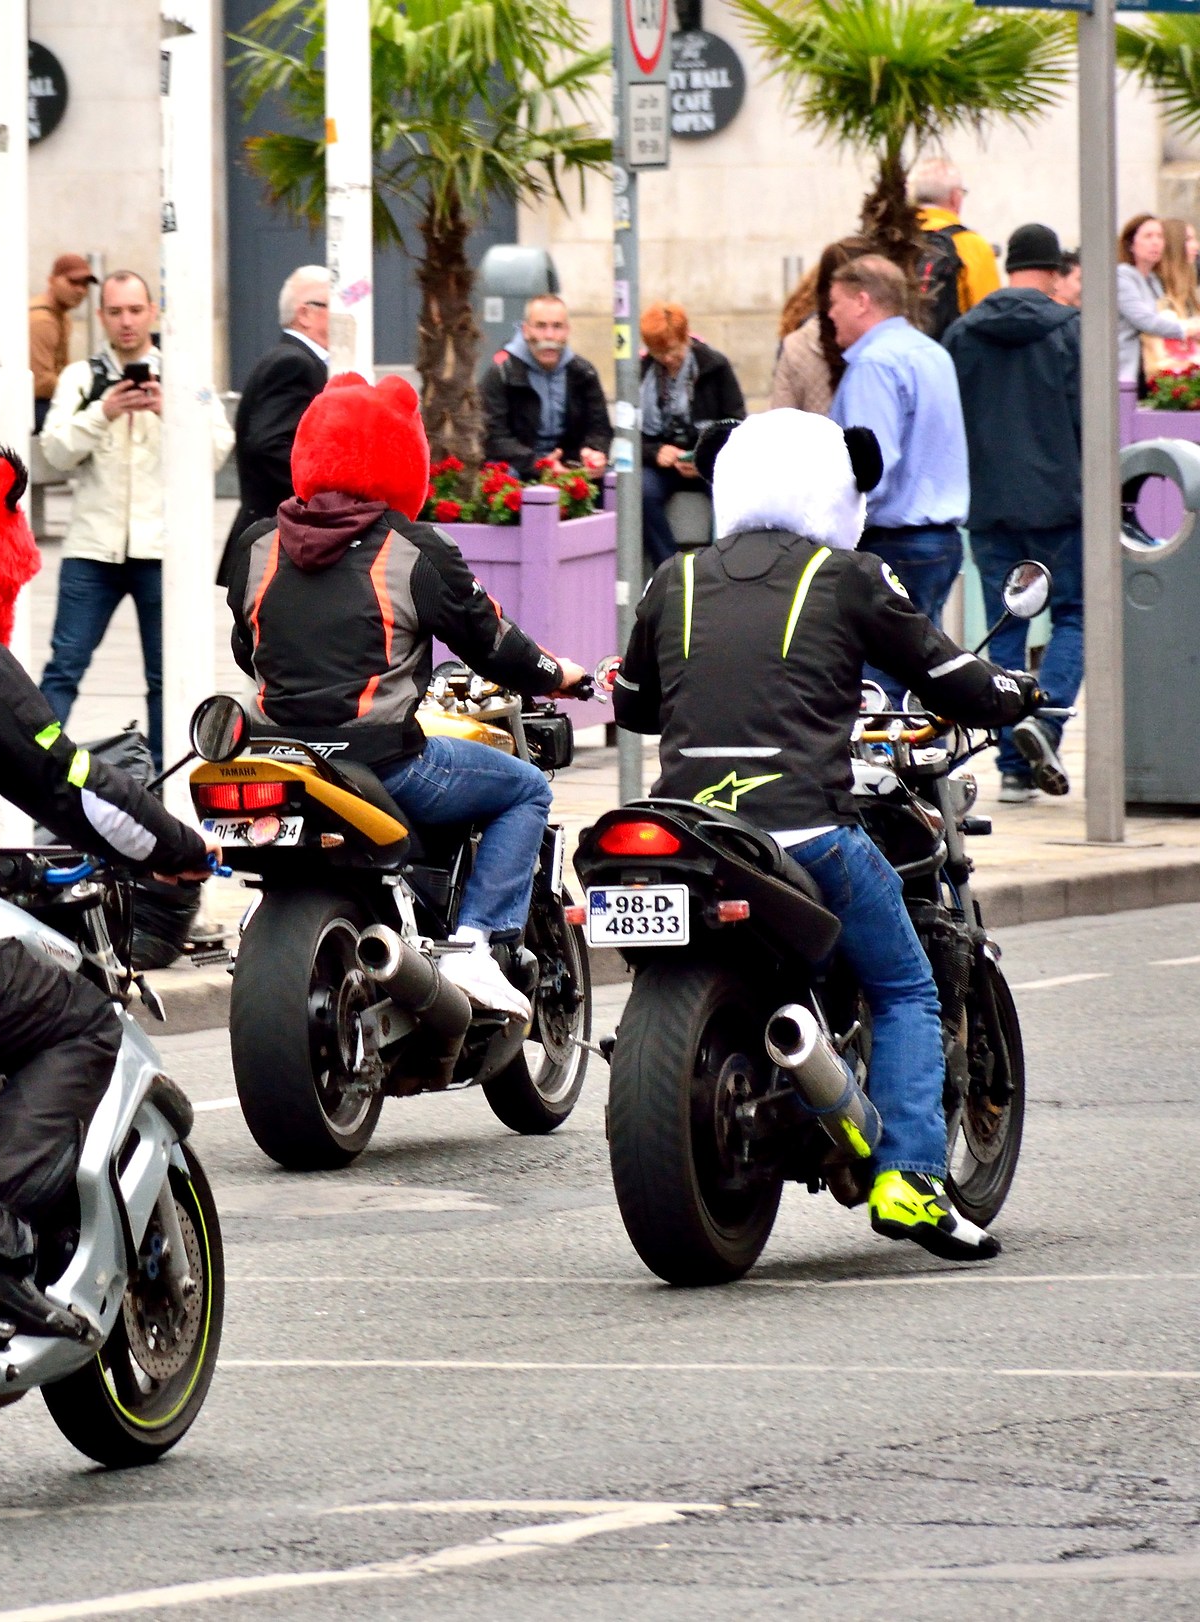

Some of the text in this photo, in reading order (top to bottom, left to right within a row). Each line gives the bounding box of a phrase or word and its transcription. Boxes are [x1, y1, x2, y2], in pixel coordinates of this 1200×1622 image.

[220, 767, 257, 777] YAMAHA
[615, 895, 670, 914] 98-D
[606, 916, 680, 935] 48333
